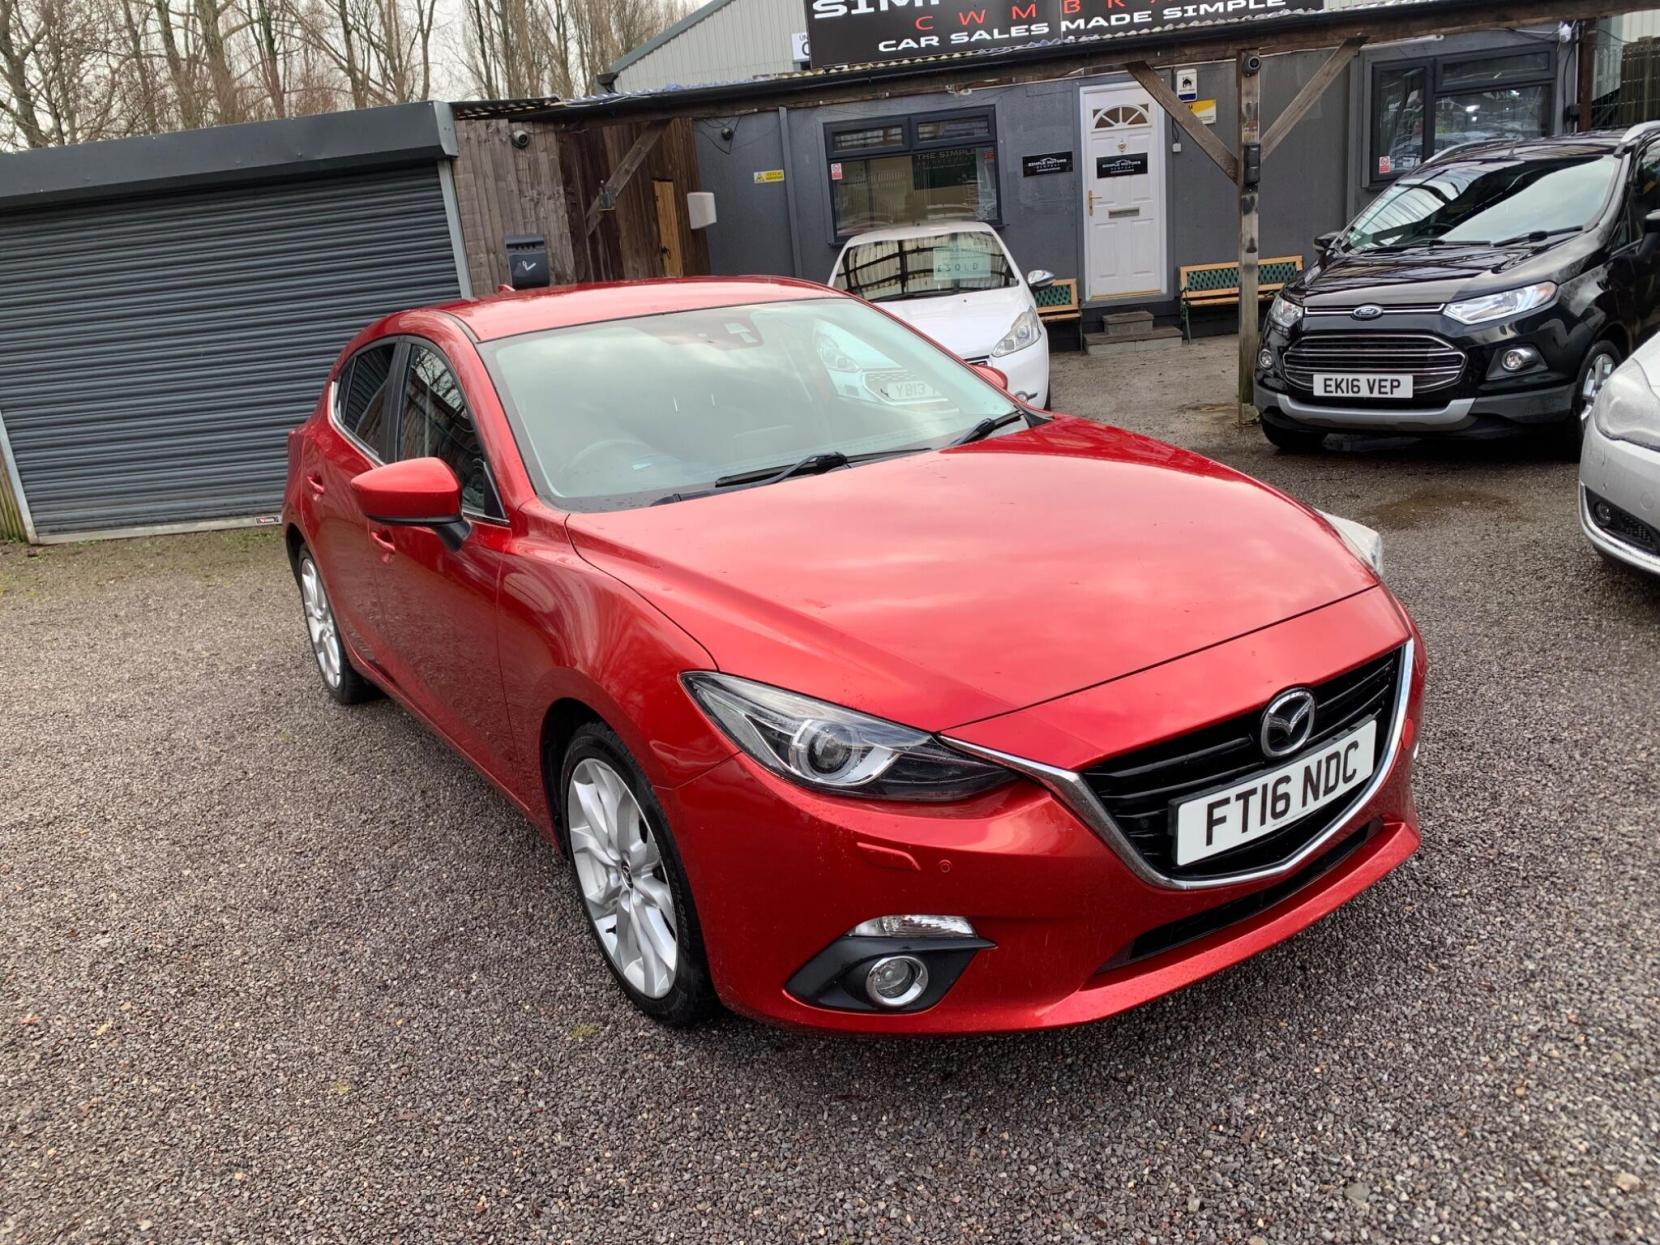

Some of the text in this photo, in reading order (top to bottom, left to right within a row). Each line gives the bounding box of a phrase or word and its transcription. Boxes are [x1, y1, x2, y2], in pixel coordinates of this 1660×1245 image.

[878, 0, 1286, 52] CAR SALES MADE SIMPLE
[896, 383, 926, 397] YB13
[1323, 378, 1401, 395] EK16 VEP
[1206, 740, 1359, 847] FT16 NDC
